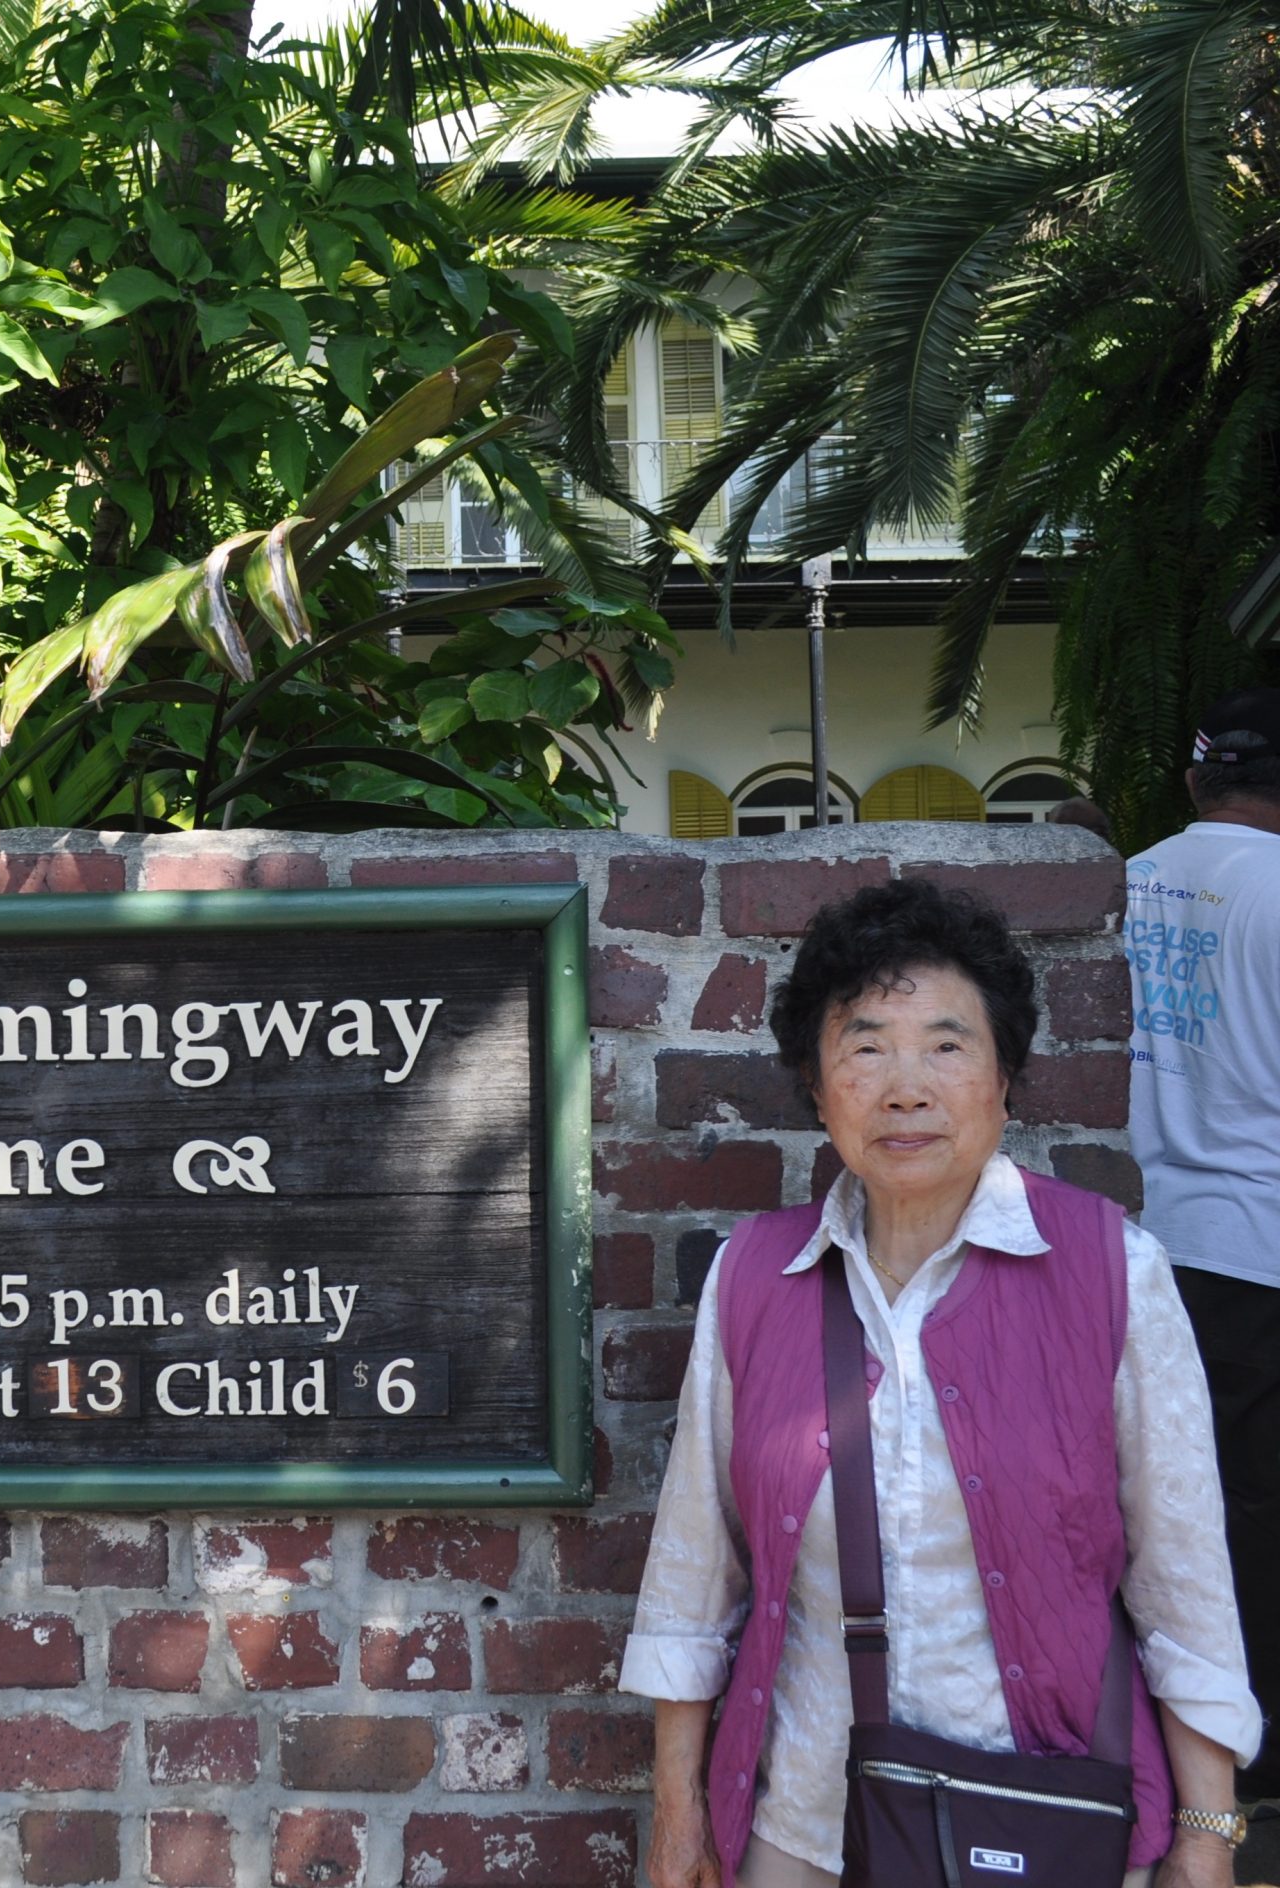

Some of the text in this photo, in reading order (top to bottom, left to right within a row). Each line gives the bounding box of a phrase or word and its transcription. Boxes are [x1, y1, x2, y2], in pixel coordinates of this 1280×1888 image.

[1127, 881, 1224, 906] orld Oceans Day
[1171, 952, 1200, 982] of
[1132, 1008, 1205, 1046] cean
[49, 1288, 184, 1345] p.m.
[205, 1266, 360, 1342] daily
[47, 1358, 124, 1414] 13
[156, 1358, 330, 1416] Child
